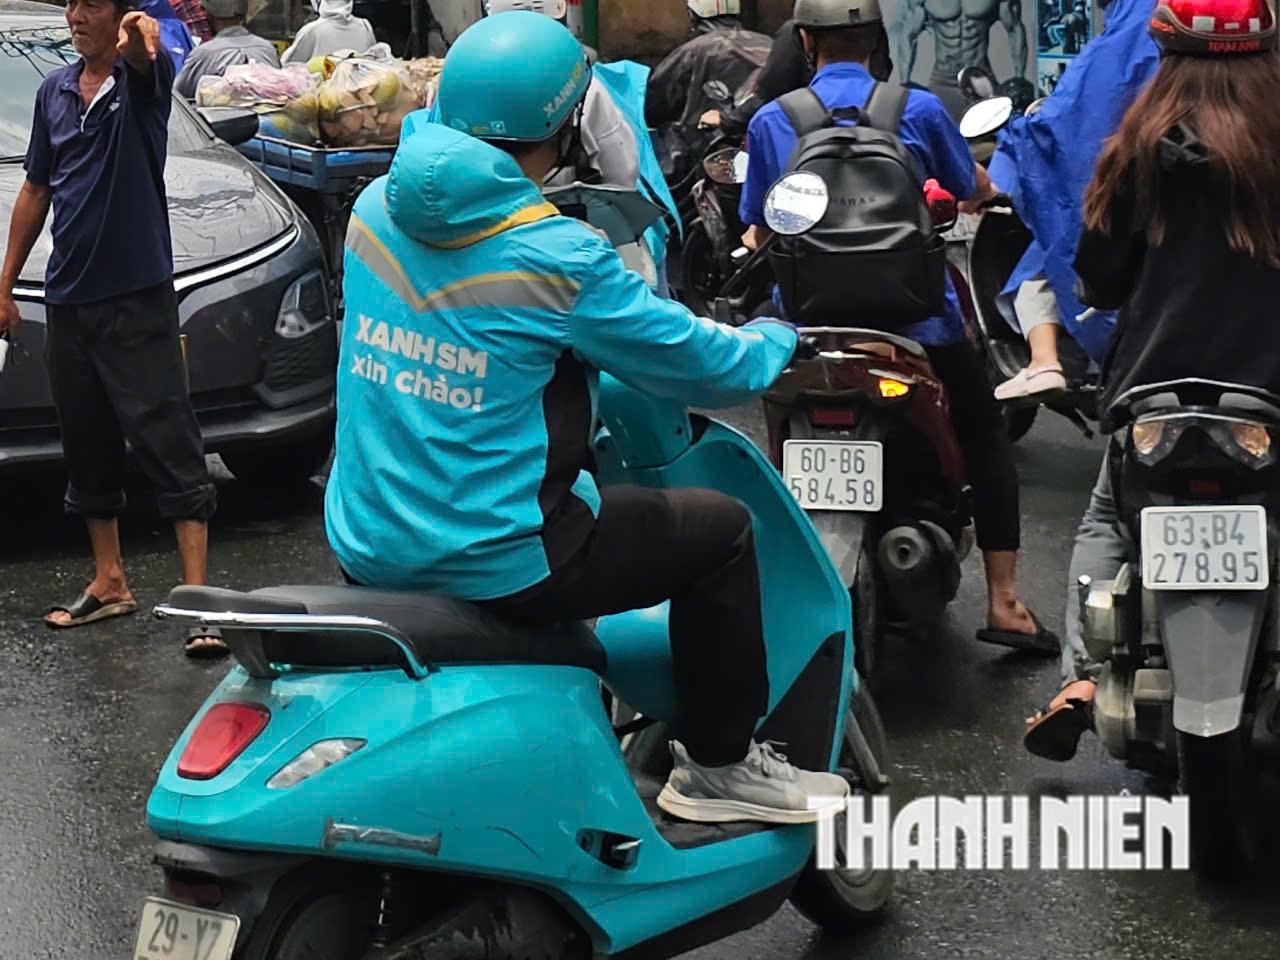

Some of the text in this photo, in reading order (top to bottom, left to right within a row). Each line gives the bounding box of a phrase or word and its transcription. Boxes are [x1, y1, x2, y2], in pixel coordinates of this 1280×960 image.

[355, 313, 488, 378] XANH SM
[351, 354, 483, 412] xin chào!
[791, 477, 875, 505] 584.58
[1152, 552, 1259, 583] 278.95
